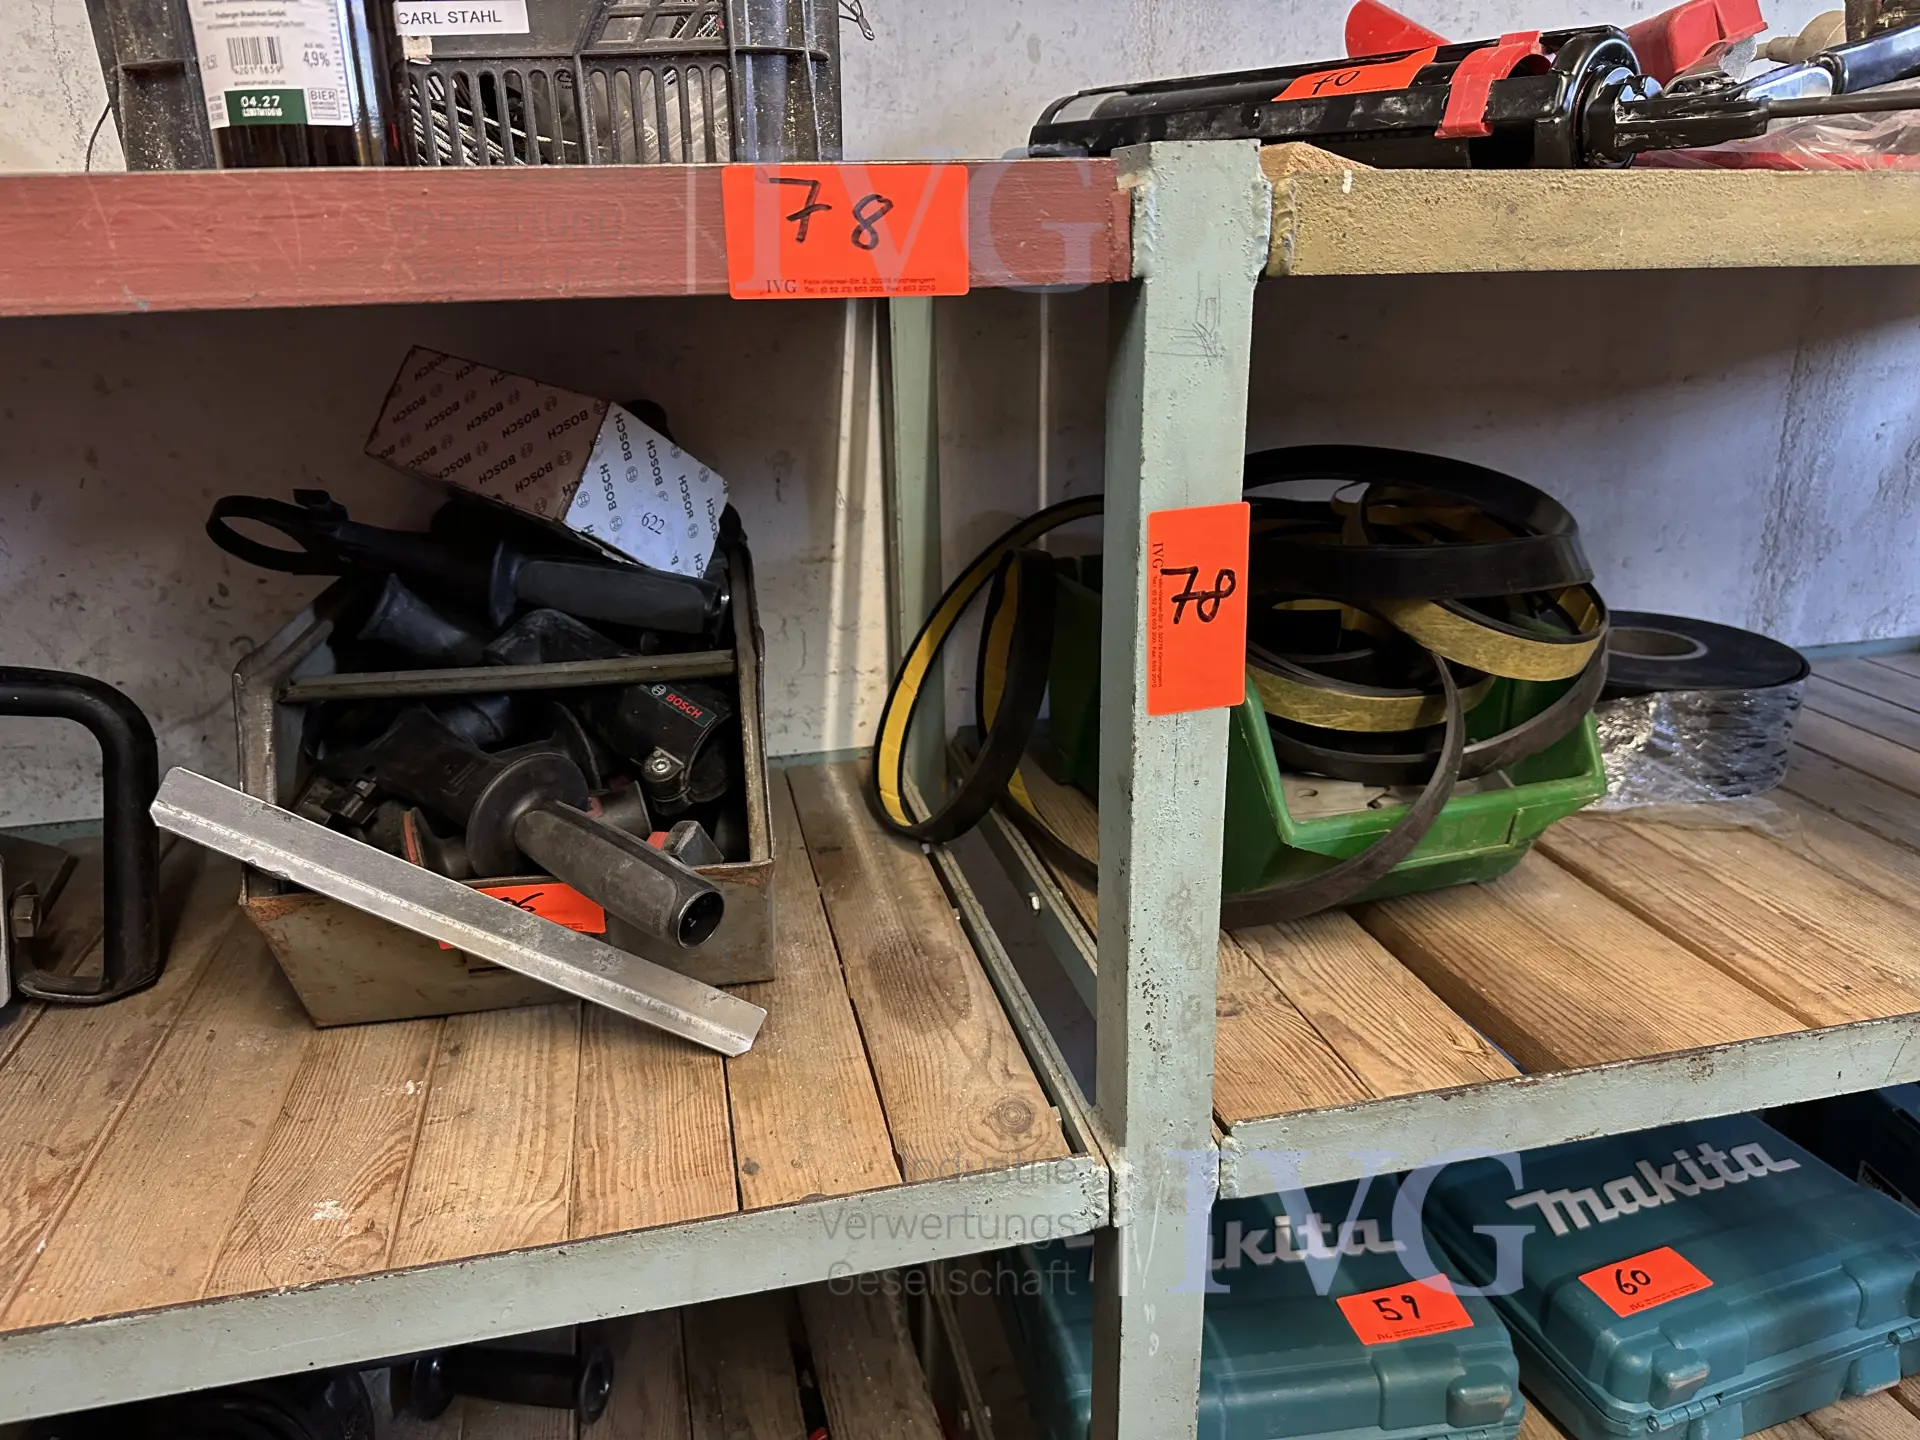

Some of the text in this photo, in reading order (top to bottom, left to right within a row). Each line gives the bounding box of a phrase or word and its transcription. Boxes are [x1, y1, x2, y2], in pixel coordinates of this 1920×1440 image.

[399, 10, 502, 25] CARL STAHL
[303, 51, 330, 68] 4,9%
[240, 95, 280, 108] 04.27
[310, 91, 336, 101] BIER
[765, 279, 798, 294] IVG
[391, 394, 428, 425] BOSCH
[424, 400, 461, 432] BOSCH
[466, 401, 505, 432] BOSCH
[501, 407, 542, 439] BOSCH
[547, 409, 590, 441] BOSCH
[614, 412, 634, 462] BOSCH
[478, 454, 517, 485] BOSCH
[514, 461, 555, 494] BOSCH
[645, 439, 665, 487] BOSCH
[599, 463, 618, 512] BOSCH
[641, 511, 666, 536] 622
[1152, 541, 1164, 569] IVG
[1160, 565, 1237, 625] 78
[665, 693, 703, 719] BOSCH
[1615, 1268, 1651, 1295] 60
[1372, 1294, 1420, 1320] 59
